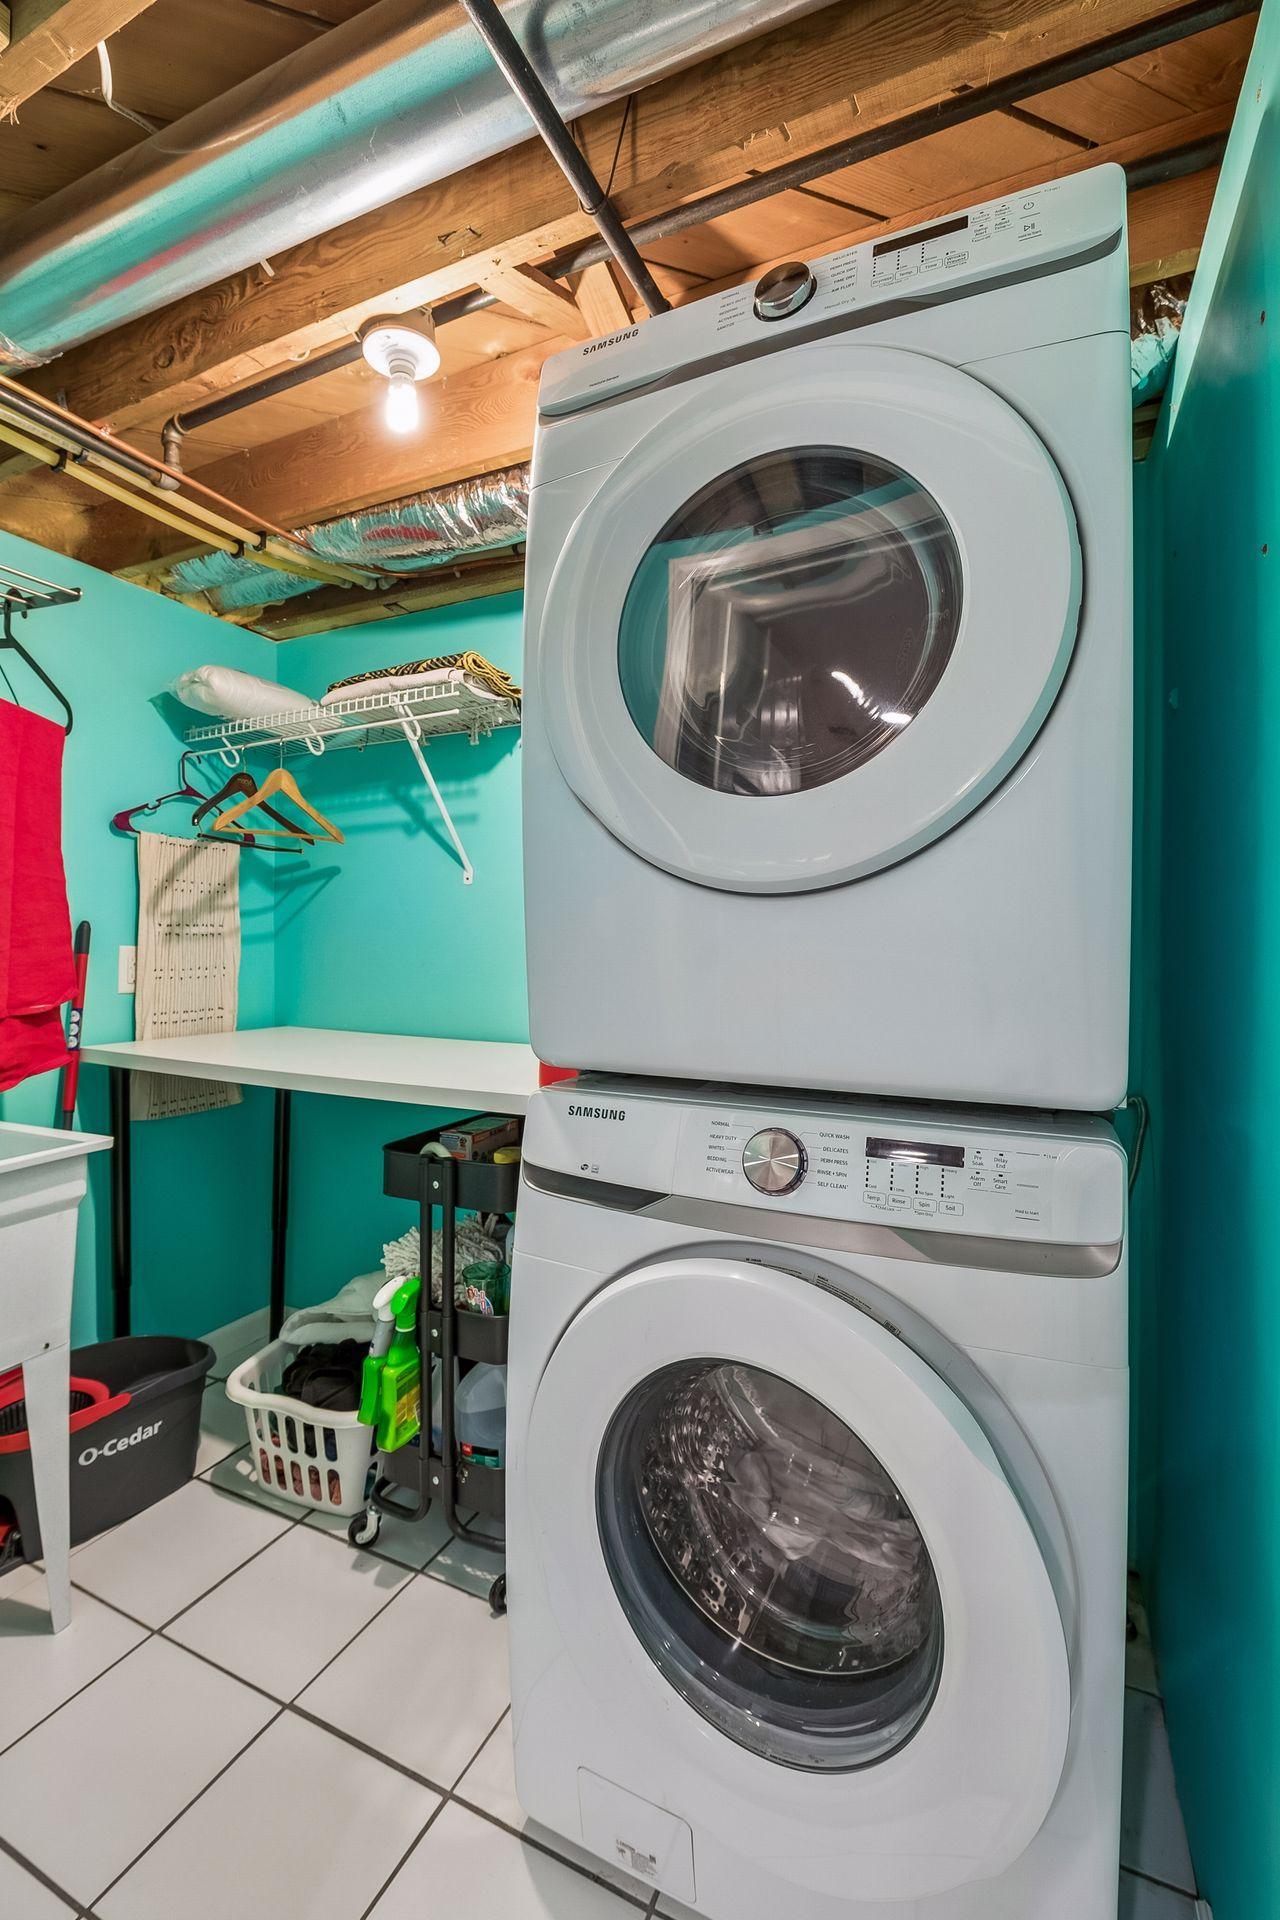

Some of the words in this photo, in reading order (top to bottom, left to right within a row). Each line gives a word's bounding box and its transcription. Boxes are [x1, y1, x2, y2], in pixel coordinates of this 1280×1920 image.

[582, 328, 640, 357] SAMSUNG
[568, 1105, 626, 1122] SAMSUNG
[711, 1120, 730, 1128] NORMAL
[819, 1131, 834, 1139] QUICK
[822, 1146, 849, 1154] DELICATES
[705, 1166, 735, 1175] ACTIVEWEAR
[891, 1197, 906, 1205] Rinse
[78, 1419, 163, 1466] O-Cedar
